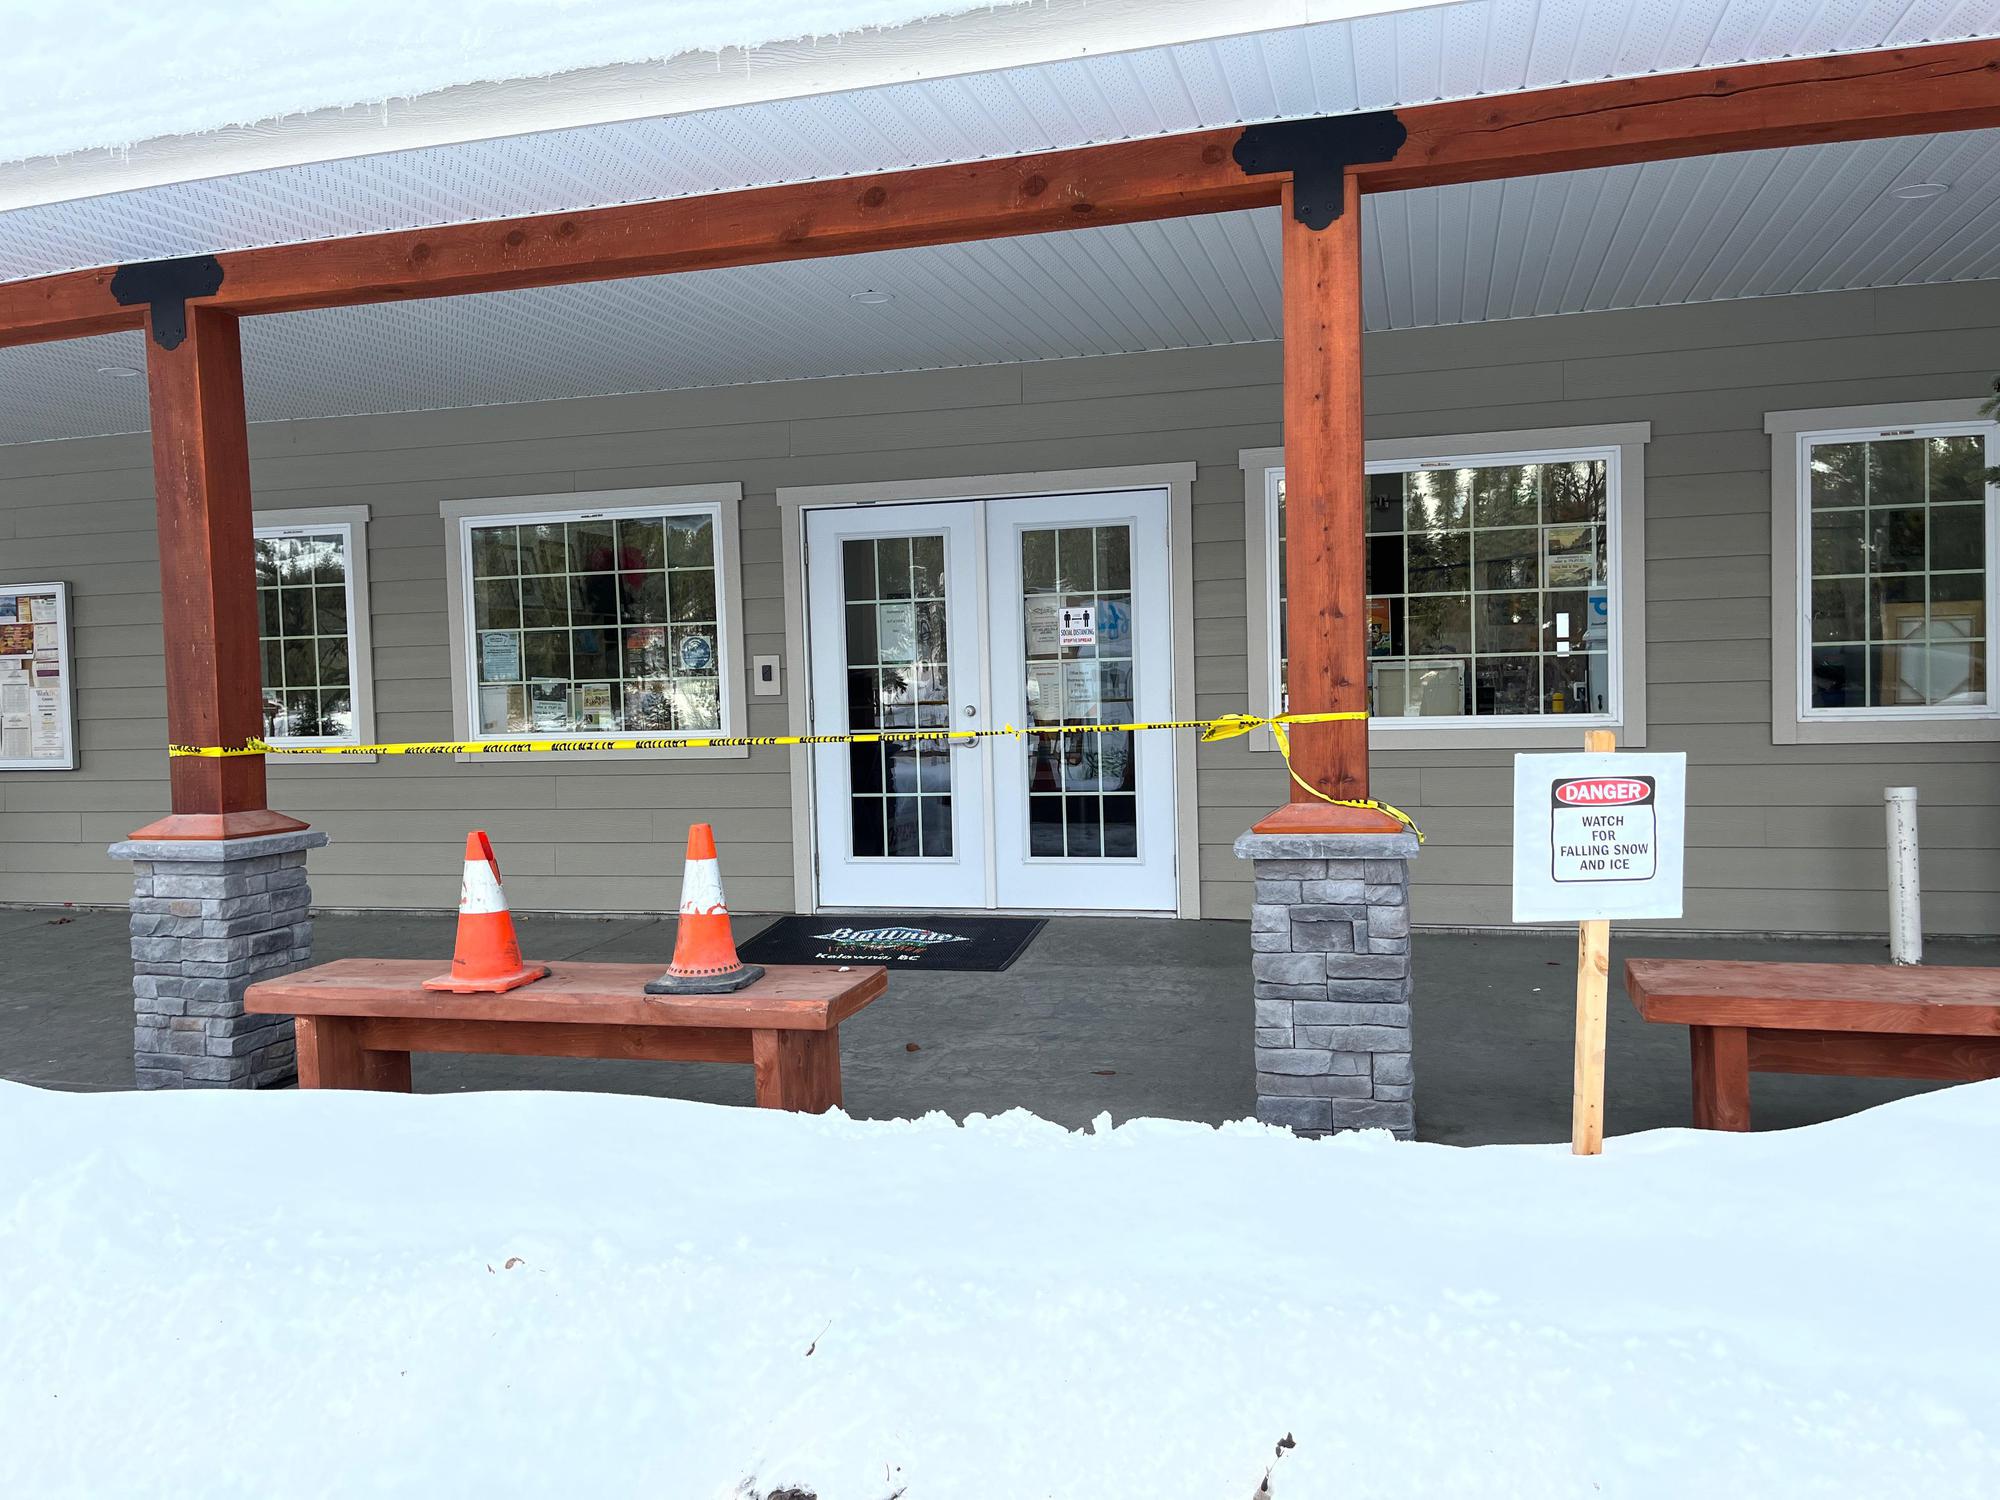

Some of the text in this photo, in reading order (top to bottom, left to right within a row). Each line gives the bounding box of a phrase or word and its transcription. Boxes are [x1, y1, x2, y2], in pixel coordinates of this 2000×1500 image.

[1565, 784, 1641, 800] DANGER
[1582, 816, 1624, 826] WATCH
[1592, 830, 1616, 841] FOR
[1560, 844, 1648, 857] FALLING SNOW
[1580, 859, 1630, 870] AND ICE
